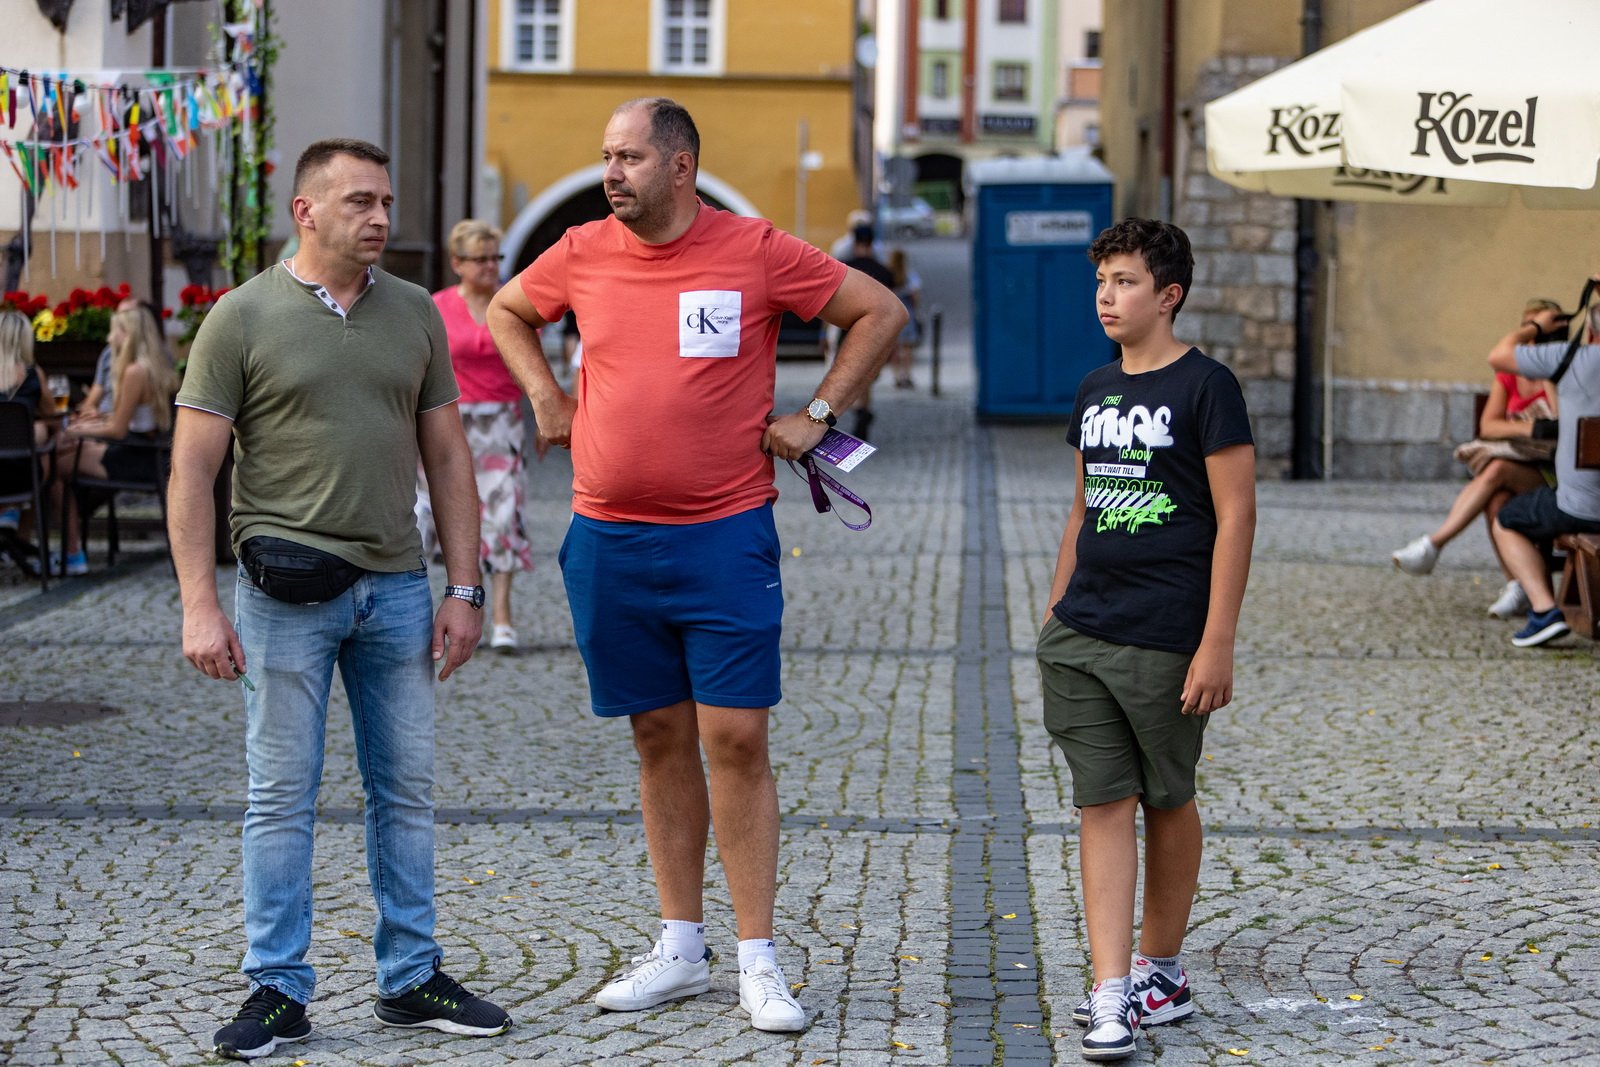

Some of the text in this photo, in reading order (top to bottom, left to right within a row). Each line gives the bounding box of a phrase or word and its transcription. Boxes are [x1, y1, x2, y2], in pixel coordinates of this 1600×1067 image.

[1266, 104, 1342, 156] Koz
[1411, 91, 1538, 165] Kozel
[1107, 466, 1121, 474] WAIT
[1122, 467, 1135, 475] TILL
[1121, 449, 1153, 461] IS NOW
